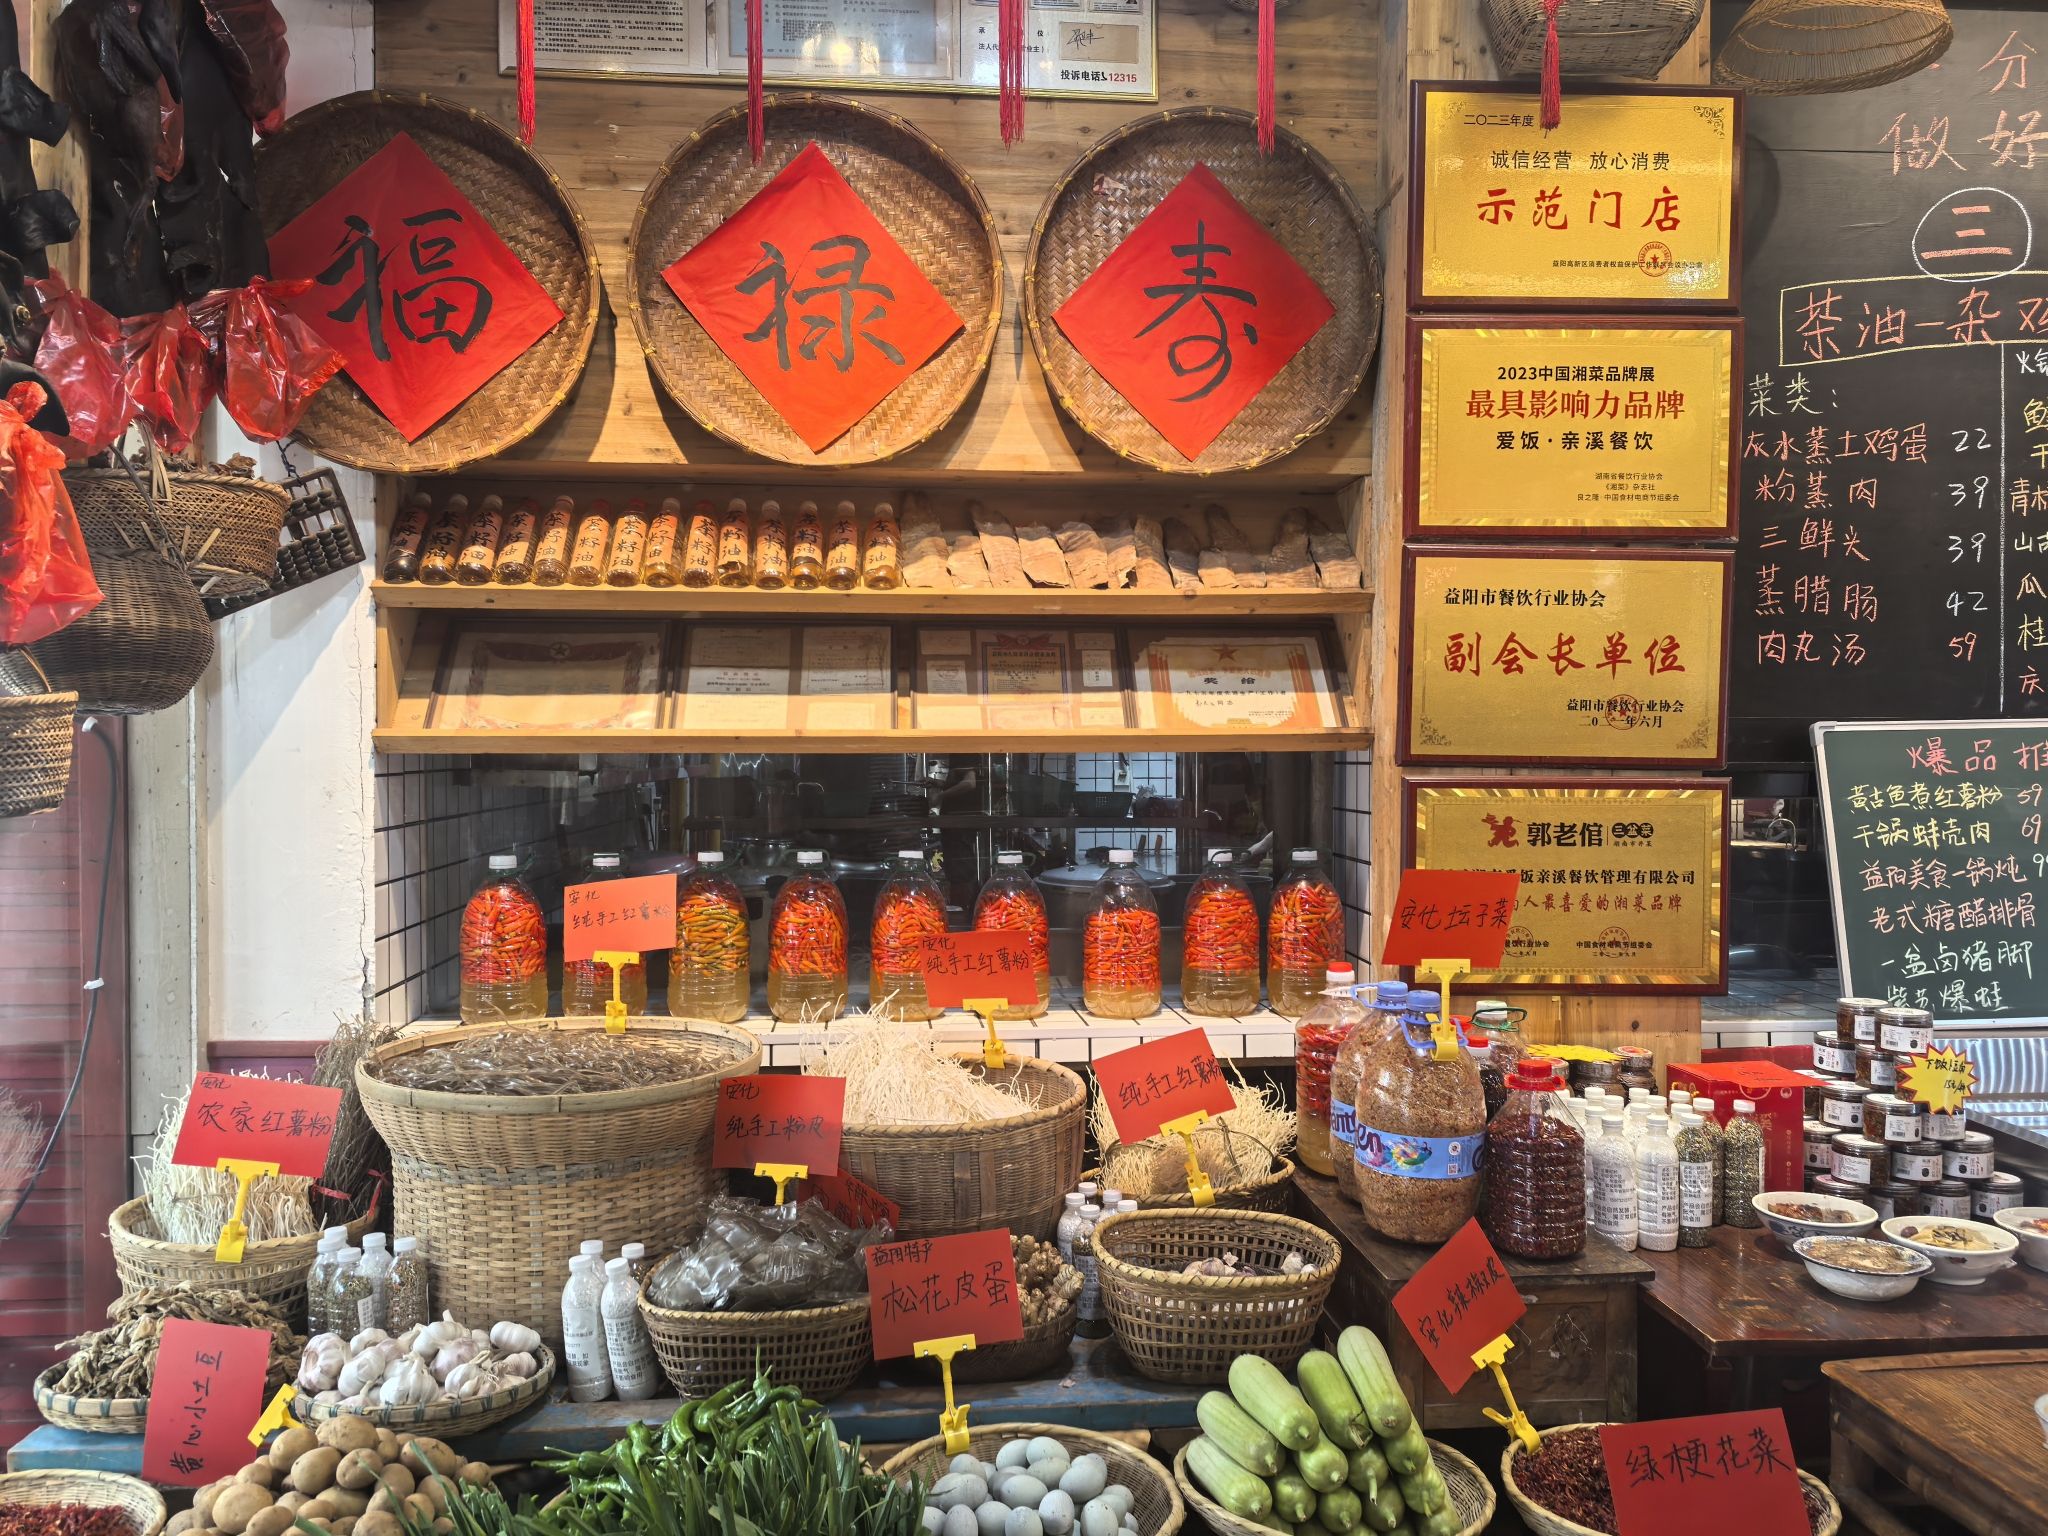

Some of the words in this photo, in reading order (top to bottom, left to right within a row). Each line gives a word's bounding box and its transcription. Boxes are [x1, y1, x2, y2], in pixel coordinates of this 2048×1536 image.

[1060, 70, 1101, 82] 投诉电话
[1109, 73, 1137, 83] 12315
[1490, 150, 1572, 171] 诚信经营
[1589, 151, 1670, 171] 放心消费
[1879, 111, 2048, 175] 做好
[1476, 186, 1681, 232] 示范门店
[1921, 205, 2013, 259] 三
[315, 207, 494, 362] 福
[735, 235, 905, 372] 禄
[1134, 219, 1258, 402] 寿
[1497, 365, 1656, 383] 2023中国湘菜品牌展
[1465, 388, 1686, 420] 最具影响力品牌
[1496, 430, 1655, 452] 爱饭·亲溪餐饮
[1951, 428, 1992, 452] 22
[1595, 472, 1664, 480] 湖南省餐饮行业协会
[1754, 467, 1878, 510] 粉蒸肉
[1948, 476, 1990, 509] 39
[1759, 517, 1872, 562] 三鲜头
[1947, 532, 1987, 563] 39
[1444, 588, 1607, 608] 益阳市餐饮行业协会
[1754, 563, 1878, 622] 蒸腊肠
[1946, 591, 1988, 617] 42
[1444, 631, 1686, 680] 副会长单位
[1758, 629, 1867, 667] 肉丸汤
[1948, 631, 1977, 662] 59
[1567, 698, 1685, 713] 益阳市餐饮行业协会
[2016, 783, 2043, 806] 59
[1526, 822, 1604, 847] 郭老倌
[2021, 813, 2043, 845] 69
[1441, 868, 1696, 885] 饭亲溪餐饮管理有限公司
[1859, 852, 2029, 891] 益阳美食一锅炖
[1400, 896, 1513, 931] 安化坛子菜
[1513, 894, 1683, 914] 人最喜爱的湘菜品牌
[1868, 892, 2037, 935] 老式糖醋排骨
[927, 946, 1029, 976] 纯手工红薯粉
[1881, 940, 2034, 980] 一盆卤猪脚
[198, 1101, 333, 1138] 农家红薯粉
[725, 1114, 825, 1142] 纯手工粉皮
[881, 1261, 1011, 1322] 松花皮蛋
[1625, 1426, 1793, 1488] 绿梗花菜
